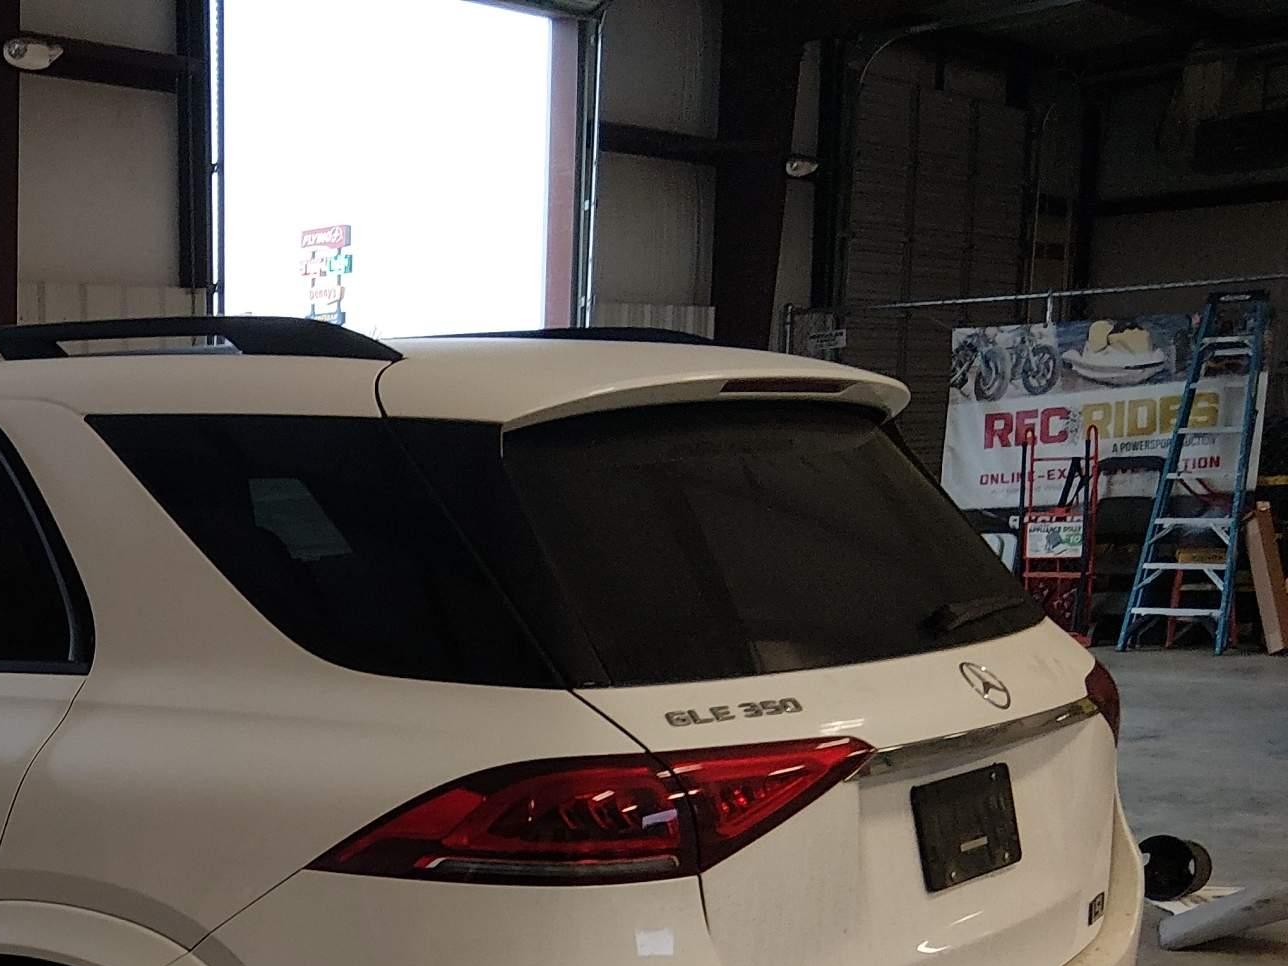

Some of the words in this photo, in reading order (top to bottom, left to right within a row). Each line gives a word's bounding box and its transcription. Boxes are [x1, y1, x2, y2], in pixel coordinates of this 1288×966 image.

[984, 407, 1069, 449] REC
[1079, 392, 1219, 439] RIDES
[1119, 438, 1176, 453] POWERSPOR
[664, 706, 736, 727] GLE
[738, 698, 803, 718] 350
